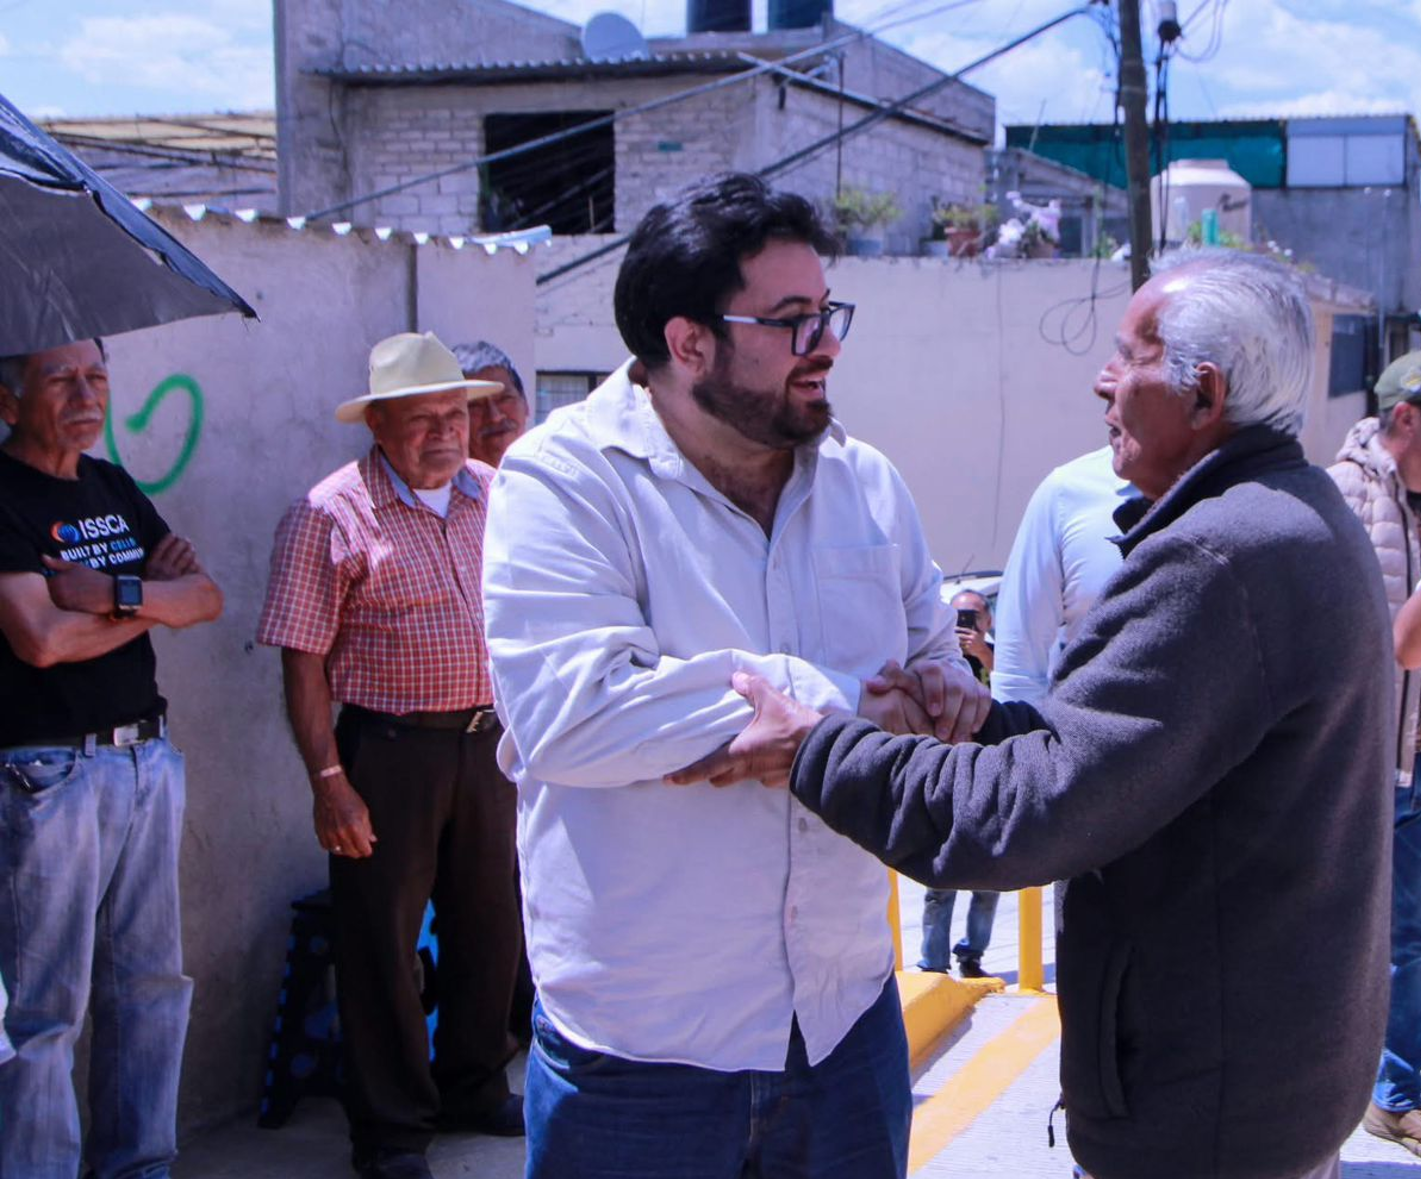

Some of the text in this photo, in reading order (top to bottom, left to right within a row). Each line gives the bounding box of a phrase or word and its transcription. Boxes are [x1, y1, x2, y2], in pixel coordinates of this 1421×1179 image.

[78, 514, 131, 540] ISSCA
[60, 545, 91, 562] BUILT
[92, 542, 108, 556] BY
